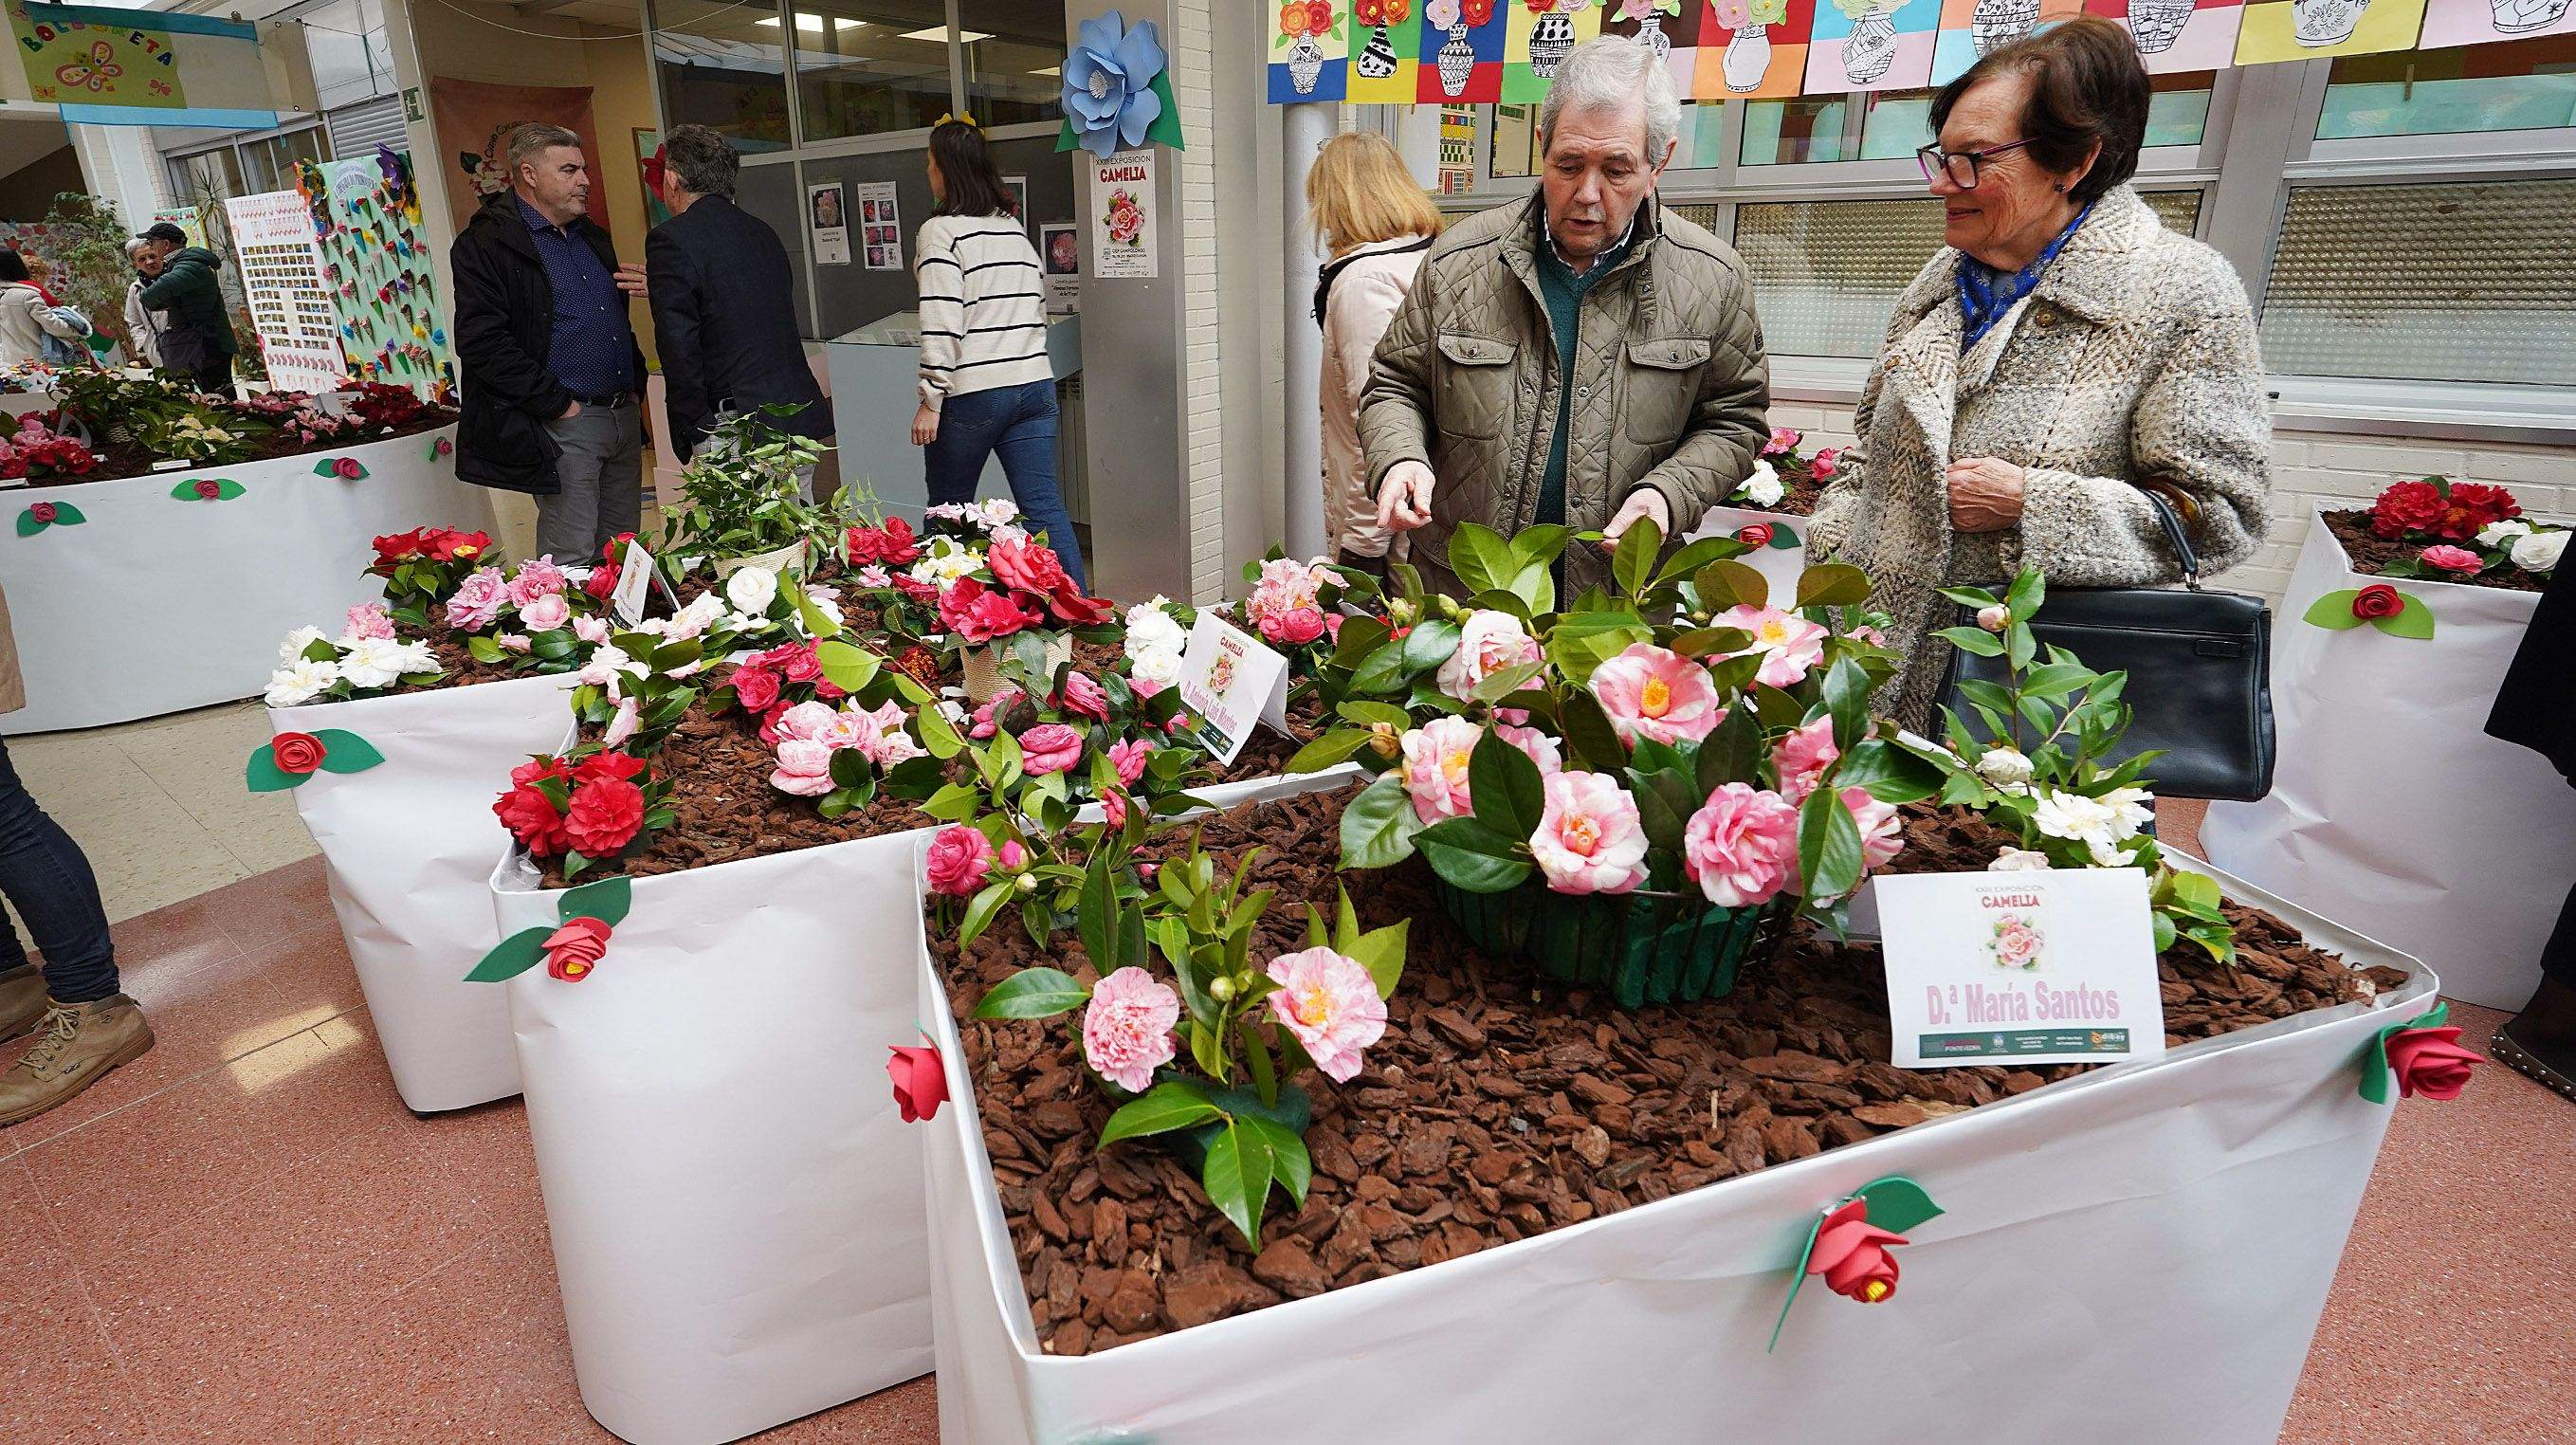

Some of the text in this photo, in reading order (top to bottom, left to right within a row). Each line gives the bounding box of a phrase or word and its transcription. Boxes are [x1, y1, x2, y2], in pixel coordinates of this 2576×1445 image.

[1100, 165, 1147, 183] CAMELIA
[1219, 636, 1244, 658] CAMELIA
[1982, 894, 2040, 908] CAMELIA
[1964, 981, 2029, 1023] María
[2035, 980, 2120, 1020] Santos
